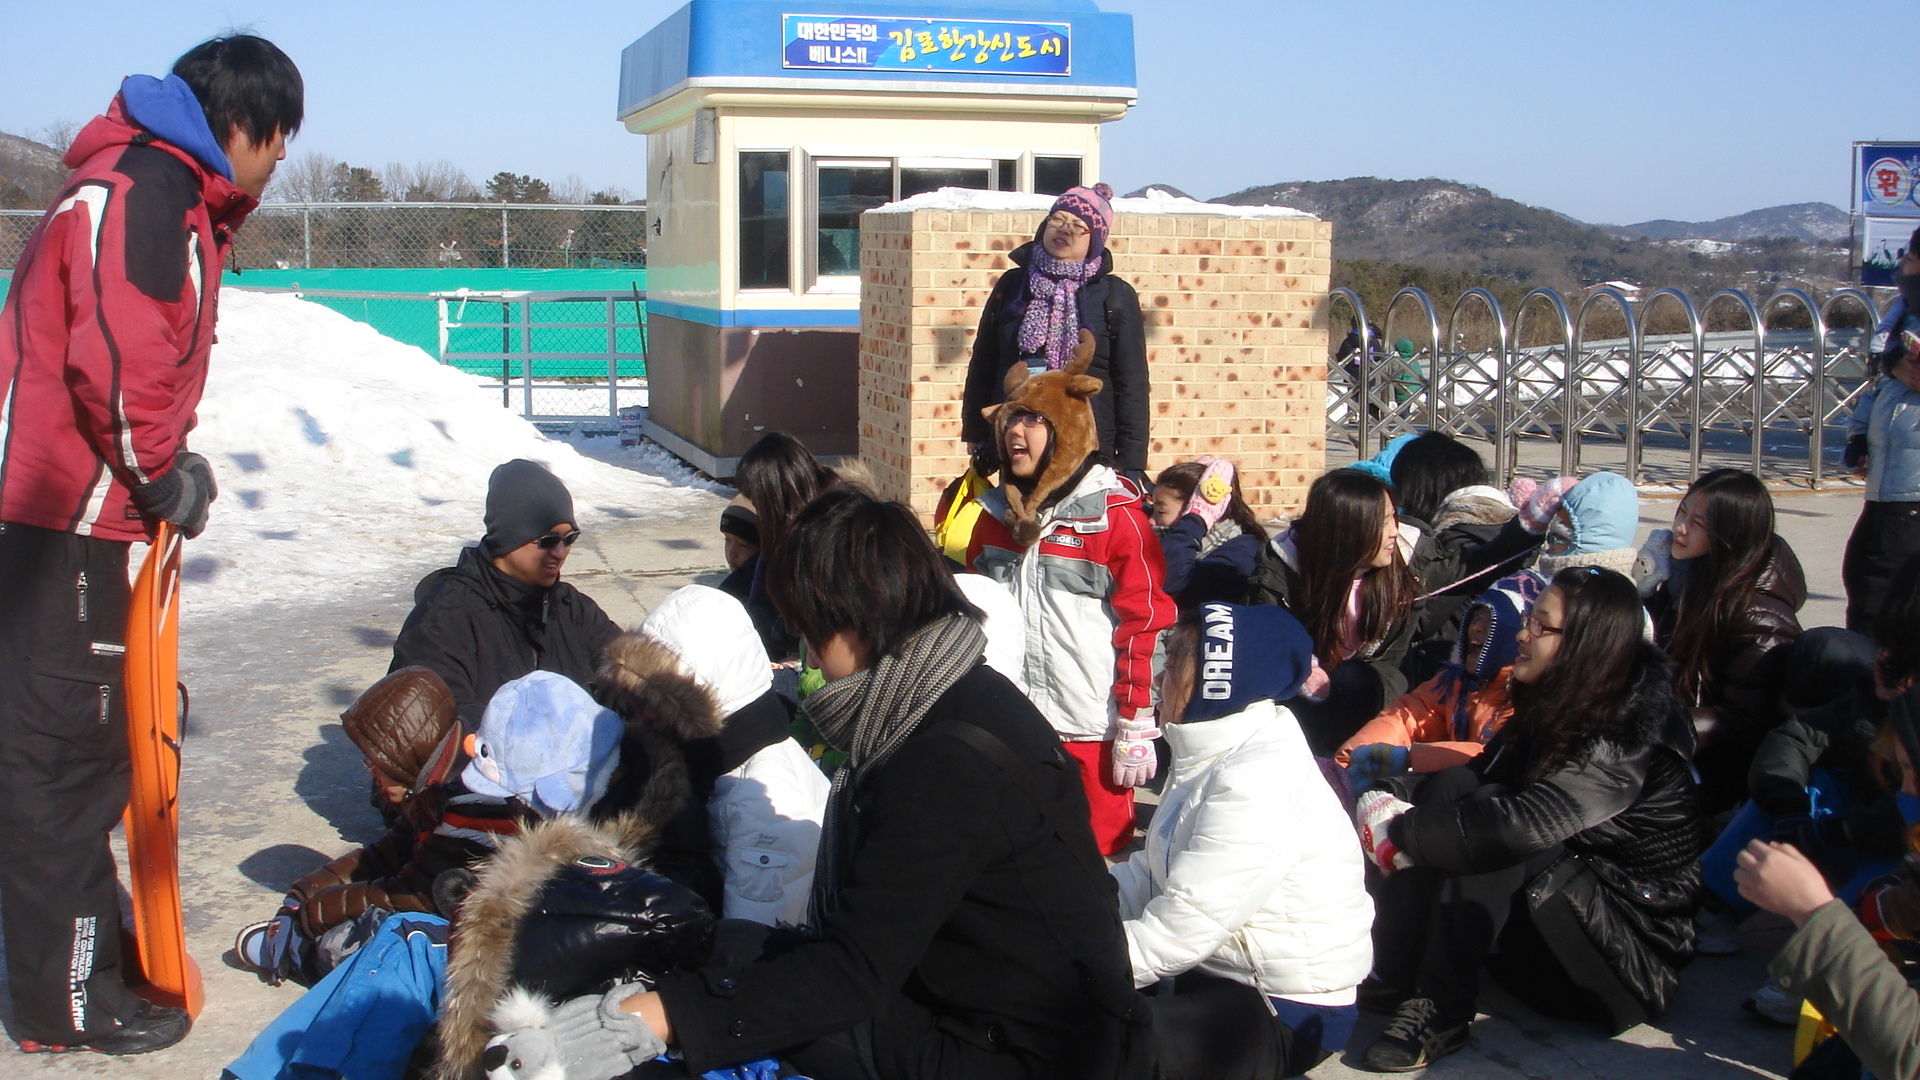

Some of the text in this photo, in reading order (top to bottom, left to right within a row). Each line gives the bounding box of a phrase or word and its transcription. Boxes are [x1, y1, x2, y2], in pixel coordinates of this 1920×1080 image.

[797, 22, 877, 42] 대한민국의
[889, 28, 1062, 63] 김포한강신도시
[809, 45, 867, 64] 베니스!!
[1876, 169, 1899, 196] 환
[1203, 604, 1234, 699] DREAM
[77, 939, 88, 981] CONTINUOUS
[71, 991, 86, 1032] Löffler
